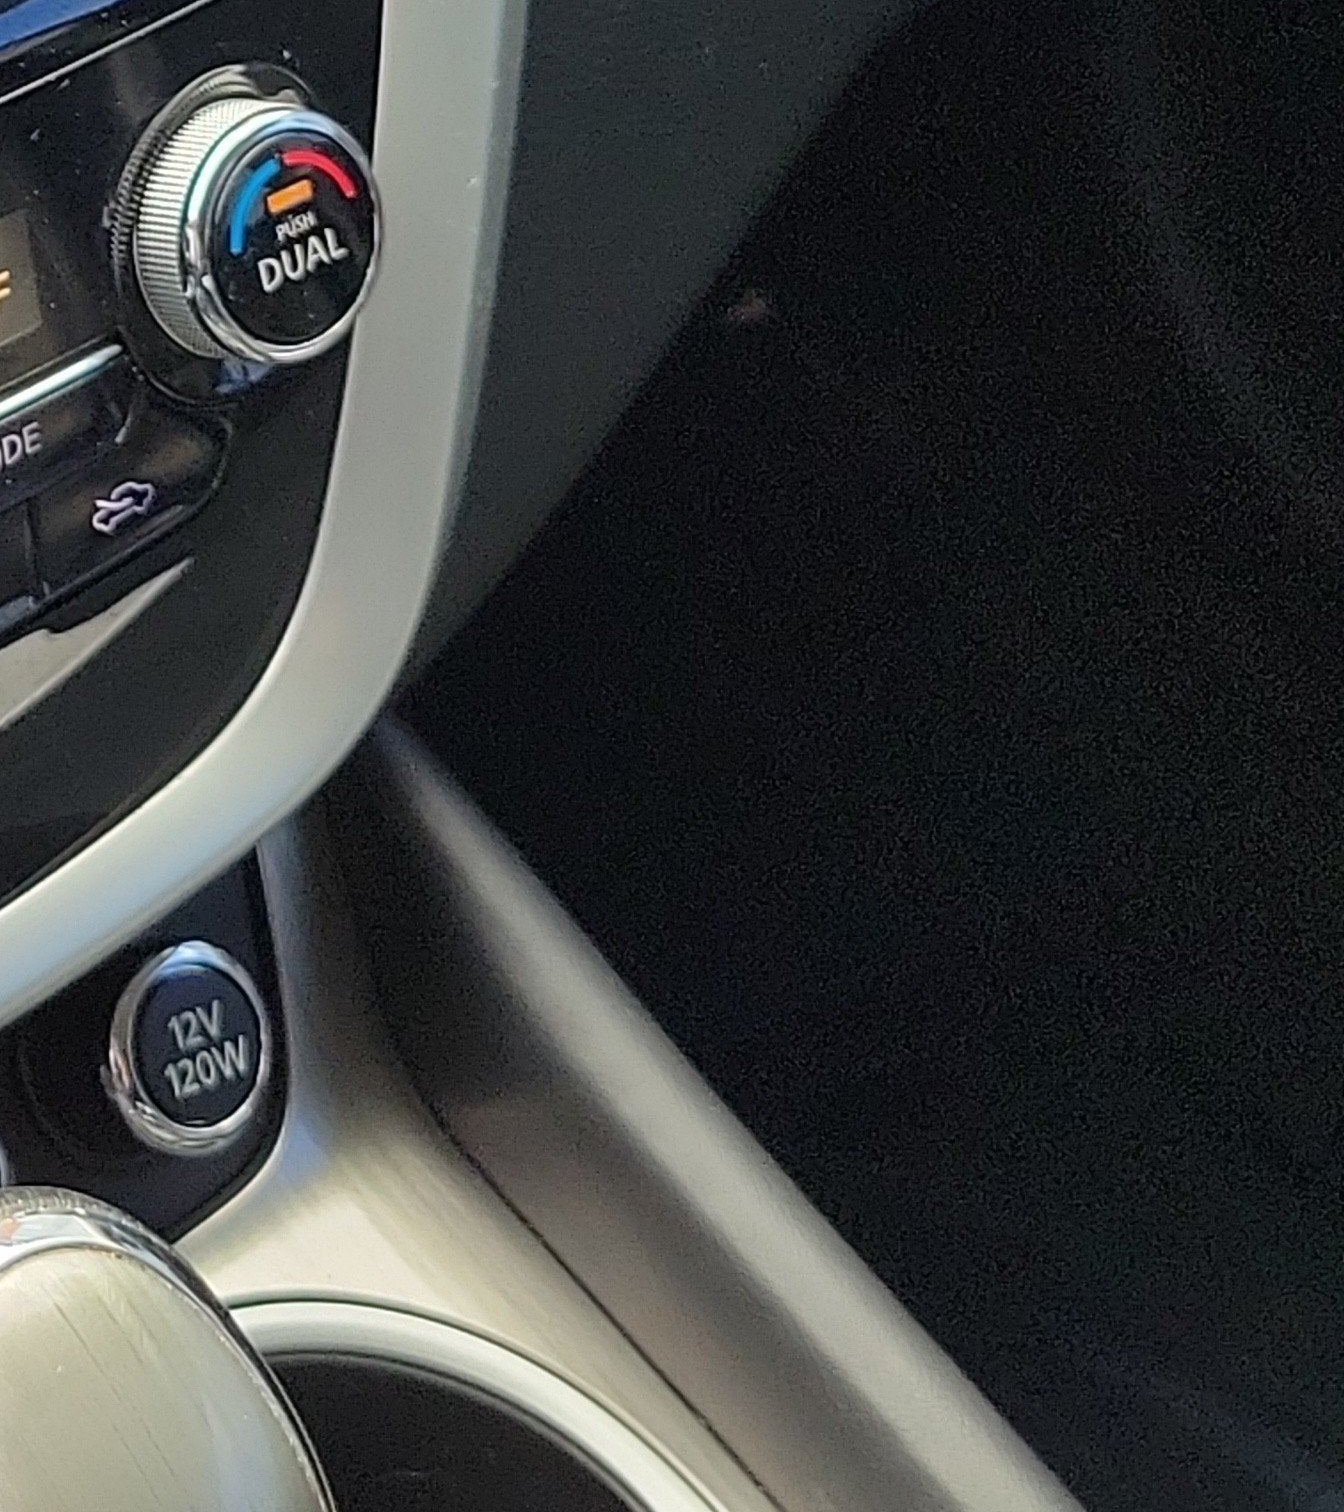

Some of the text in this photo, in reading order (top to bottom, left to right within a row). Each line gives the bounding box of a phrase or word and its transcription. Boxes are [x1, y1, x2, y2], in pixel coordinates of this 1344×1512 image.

[275, 209, 317, 242] PUSH
[257, 227, 350, 294] DUAL
[166, 999, 226, 1051] 12V
[162, 1033, 250, 1099] 120W
